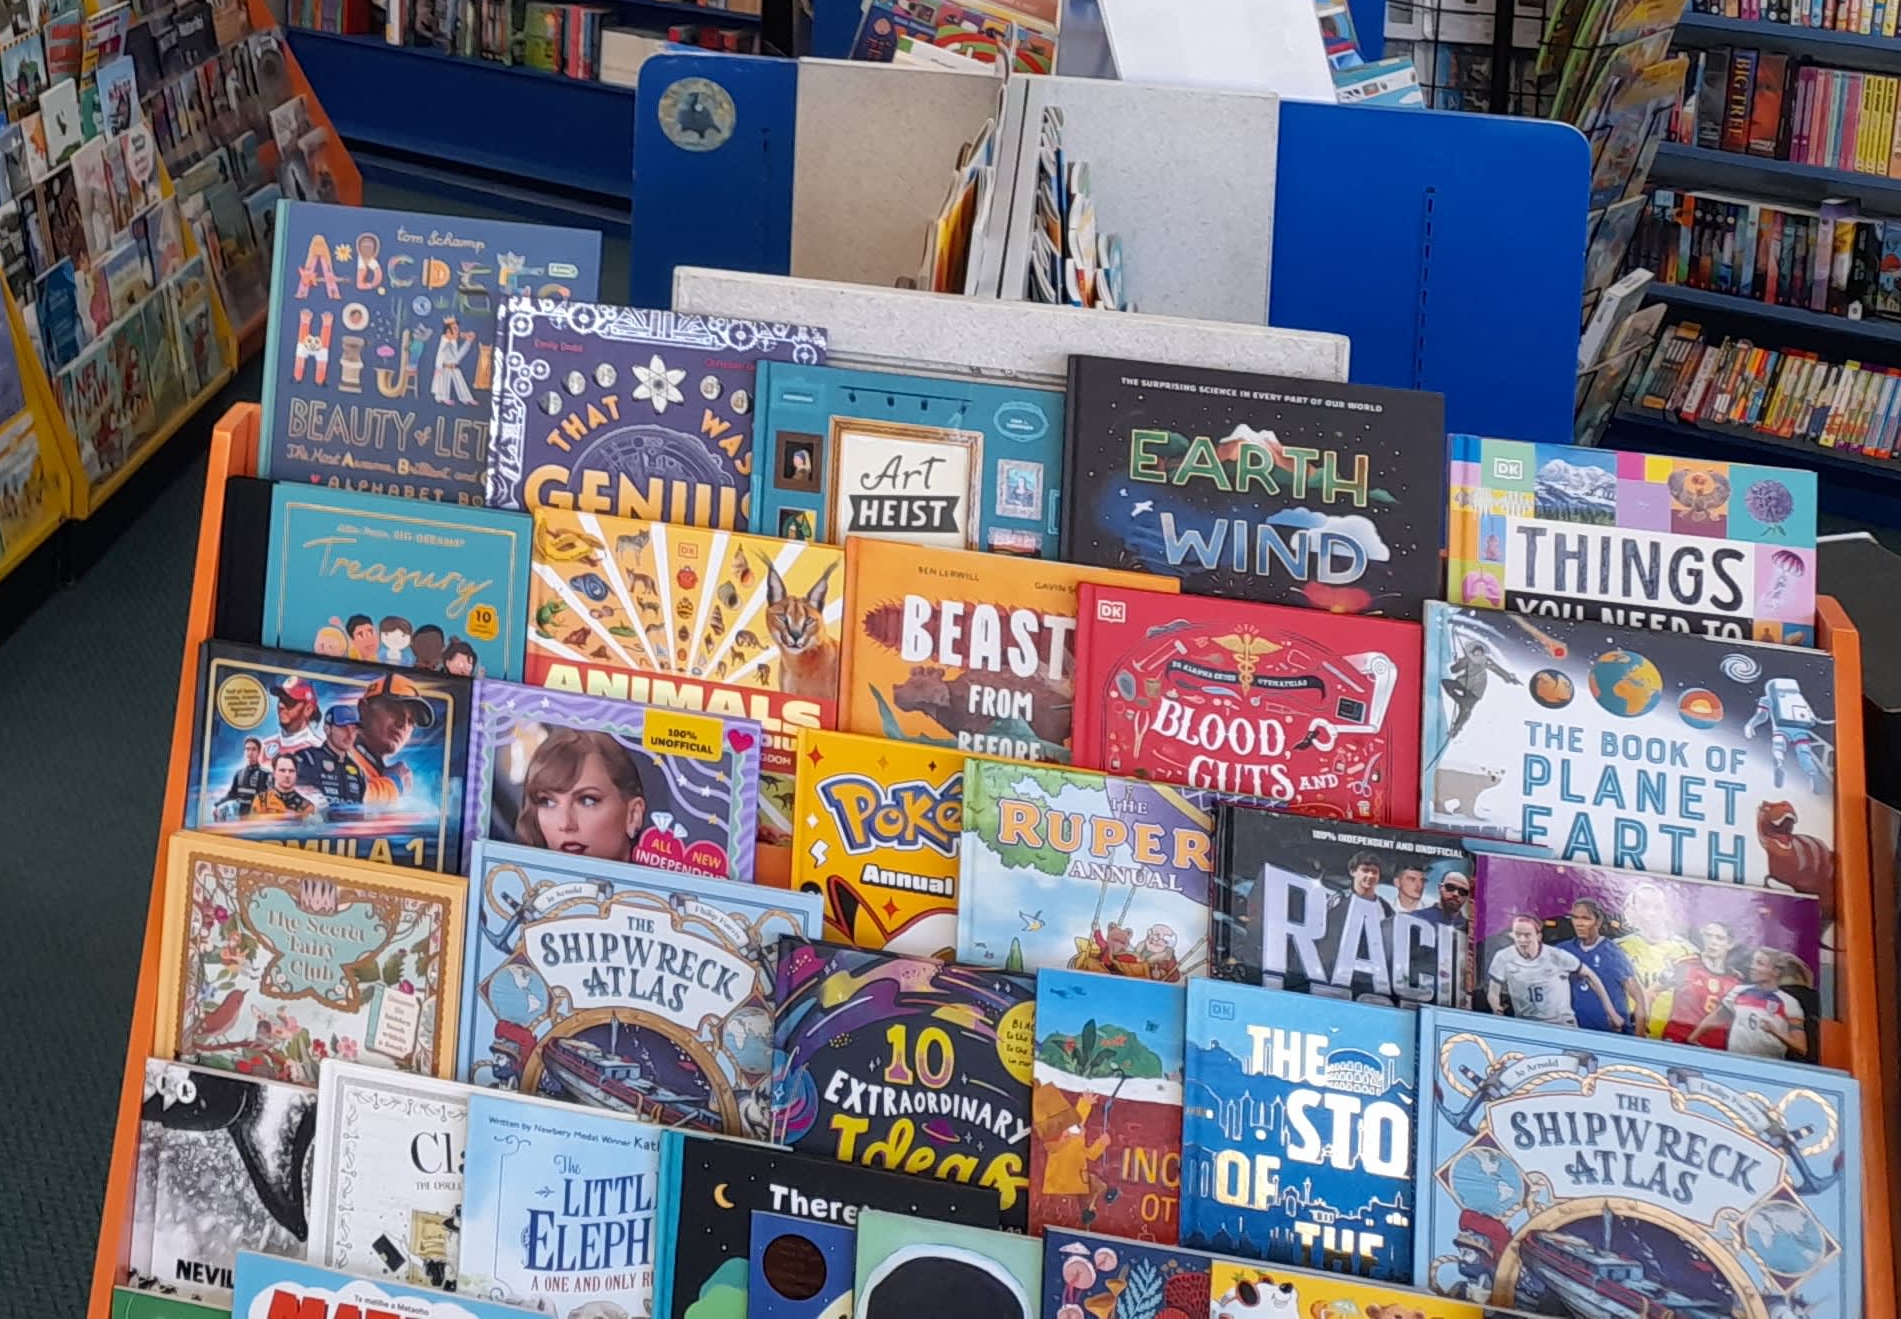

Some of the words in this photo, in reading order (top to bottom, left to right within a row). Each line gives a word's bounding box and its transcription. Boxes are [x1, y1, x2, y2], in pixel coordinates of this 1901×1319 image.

[1736, 54, 1753, 94] BIG
[1728, 96, 1749, 140] TREE
[397, 226, 425, 244] tom
[427, 229, 486, 252] Schamp
[1121, 376, 1139, 387] THE
[1141, 379, 1197, 393] SURPRISING
[1199, 385, 1238, 398] SCIENCE
[1240, 390, 1251, 398] IN
[1253, 391, 1282, 403] EVERY
[1284, 395, 1309, 405] PART
[1311, 397, 1323, 406] OF
[1325, 399, 1346, 409] OUR
[1347, 401, 1384, 413] WORLD
[287, 396, 416, 452] BEAUTY
[546, 395, 620, 452] THAT
[860, 454, 947, 492] Art
[1129, 428, 1369, 508] EARTH
[1496, 461, 1520, 478] DK
[327, 475, 445, 503] ALPHABET
[859, 498, 949, 530] HEIST
[1159, 511, 1368, 585] WIND
[303, 536, 494, 620] Treasury
[918, 565, 938, 576] BEN
[939, 566, 980, 582] LERWILL
[1516, 525, 1746, 613] THINGS
[475, 609, 493, 625] 10
[1100, 603, 1123, 619] DK
[901, 594, 1076, 681] BEAST
[543, 663, 824, 732] ANIMALS
[968, 684, 1035, 723] FROM
[650, 736, 714, 755] UNOFFICIAL
[667, 727, 698, 741] 100%
[1150, 695, 1293, 761] BLOOD,
[1525, 720, 1583, 754] THE
[1600, 732, 1688, 768] BOOK
[1705, 745, 1747, 775] OF
[1299, 773, 1339, 792] AND
[1522, 752, 1747, 826] PLANET
[1107, 798, 1140, 816] THE
[651, 838, 674, 854] ALL
[691, 851, 723, 868] NEW
[1337, 833, 1395, 849] INDEPENDENT
[1395, 841, 1414, 852] AND
[1415, 843, 1463, 859] UNOFFICIAL
[1521, 804, 1745, 886] EARTH
[861, 865, 954, 896] Annual
[1068, 862, 1184, 893] ANNUAL
[266, 909, 299, 934] The
[306, 918, 366, 944] Secret
[627, 916, 655, 934] THE
[286, 936, 338, 962] Fairy
[540, 931, 735, 1003] SHIPWRECK
[289, 959, 334, 982] Club
[582, 964, 689, 1014] ATLAS
[1528, 986, 1546, 1003] 16
[1748, 1013, 1760, 1030] 6
[884, 1024, 958, 1089] 10
[1246, 1023, 1328, 1085] THE
[824, 1069, 1032, 1143] EXTRAORDINARY
[1615, 1093, 1652, 1114] THE
[488, 1115, 520, 1129] Written
[521, 1122, 532, 1132] by
[534, 1123, 572, 1139] Newbery
[574, 1130, 600, 1142] Medal
[601, 1135, 632, 1147] Winner
[553, 1154, 582, 1176] The
[1510, 1107, 1765, 1194] SHIPWRECK
[1217, 1150, 1281, 1211] OF
[1566, 1150, 1695, 1205] ATLAS
[531, 1276, 539, 1291] A
[545, 1277, 569, 1292] ONE
[574, 1276, 601, 1292] AND
[604, 1273, 637, 1290] ONLY
